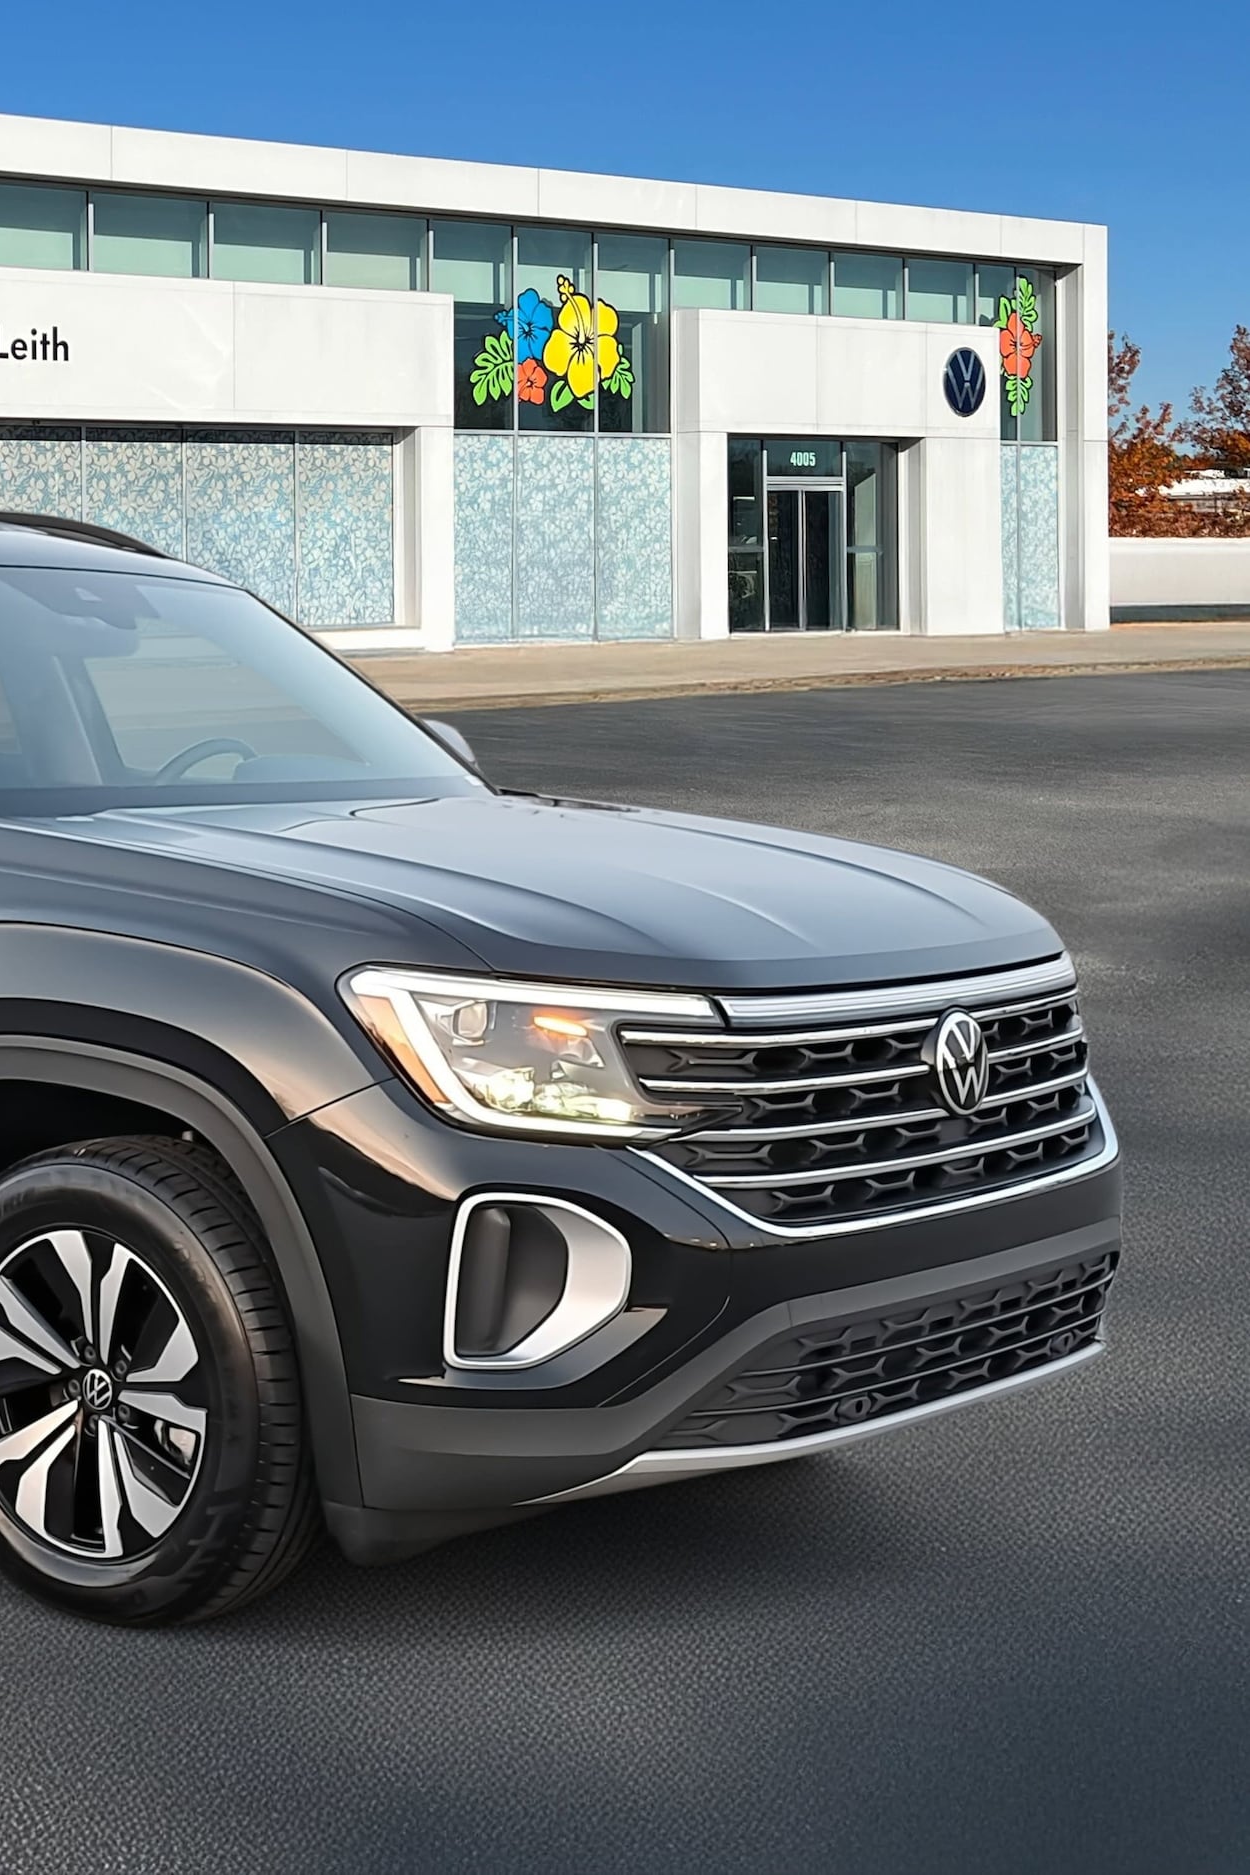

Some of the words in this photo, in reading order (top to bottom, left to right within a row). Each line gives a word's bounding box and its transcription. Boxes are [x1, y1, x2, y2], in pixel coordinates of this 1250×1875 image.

[945, 348, 985, 413] VW
[790, 452, 816, 466] 4005
[938, 1012, 988, 1113] VW
